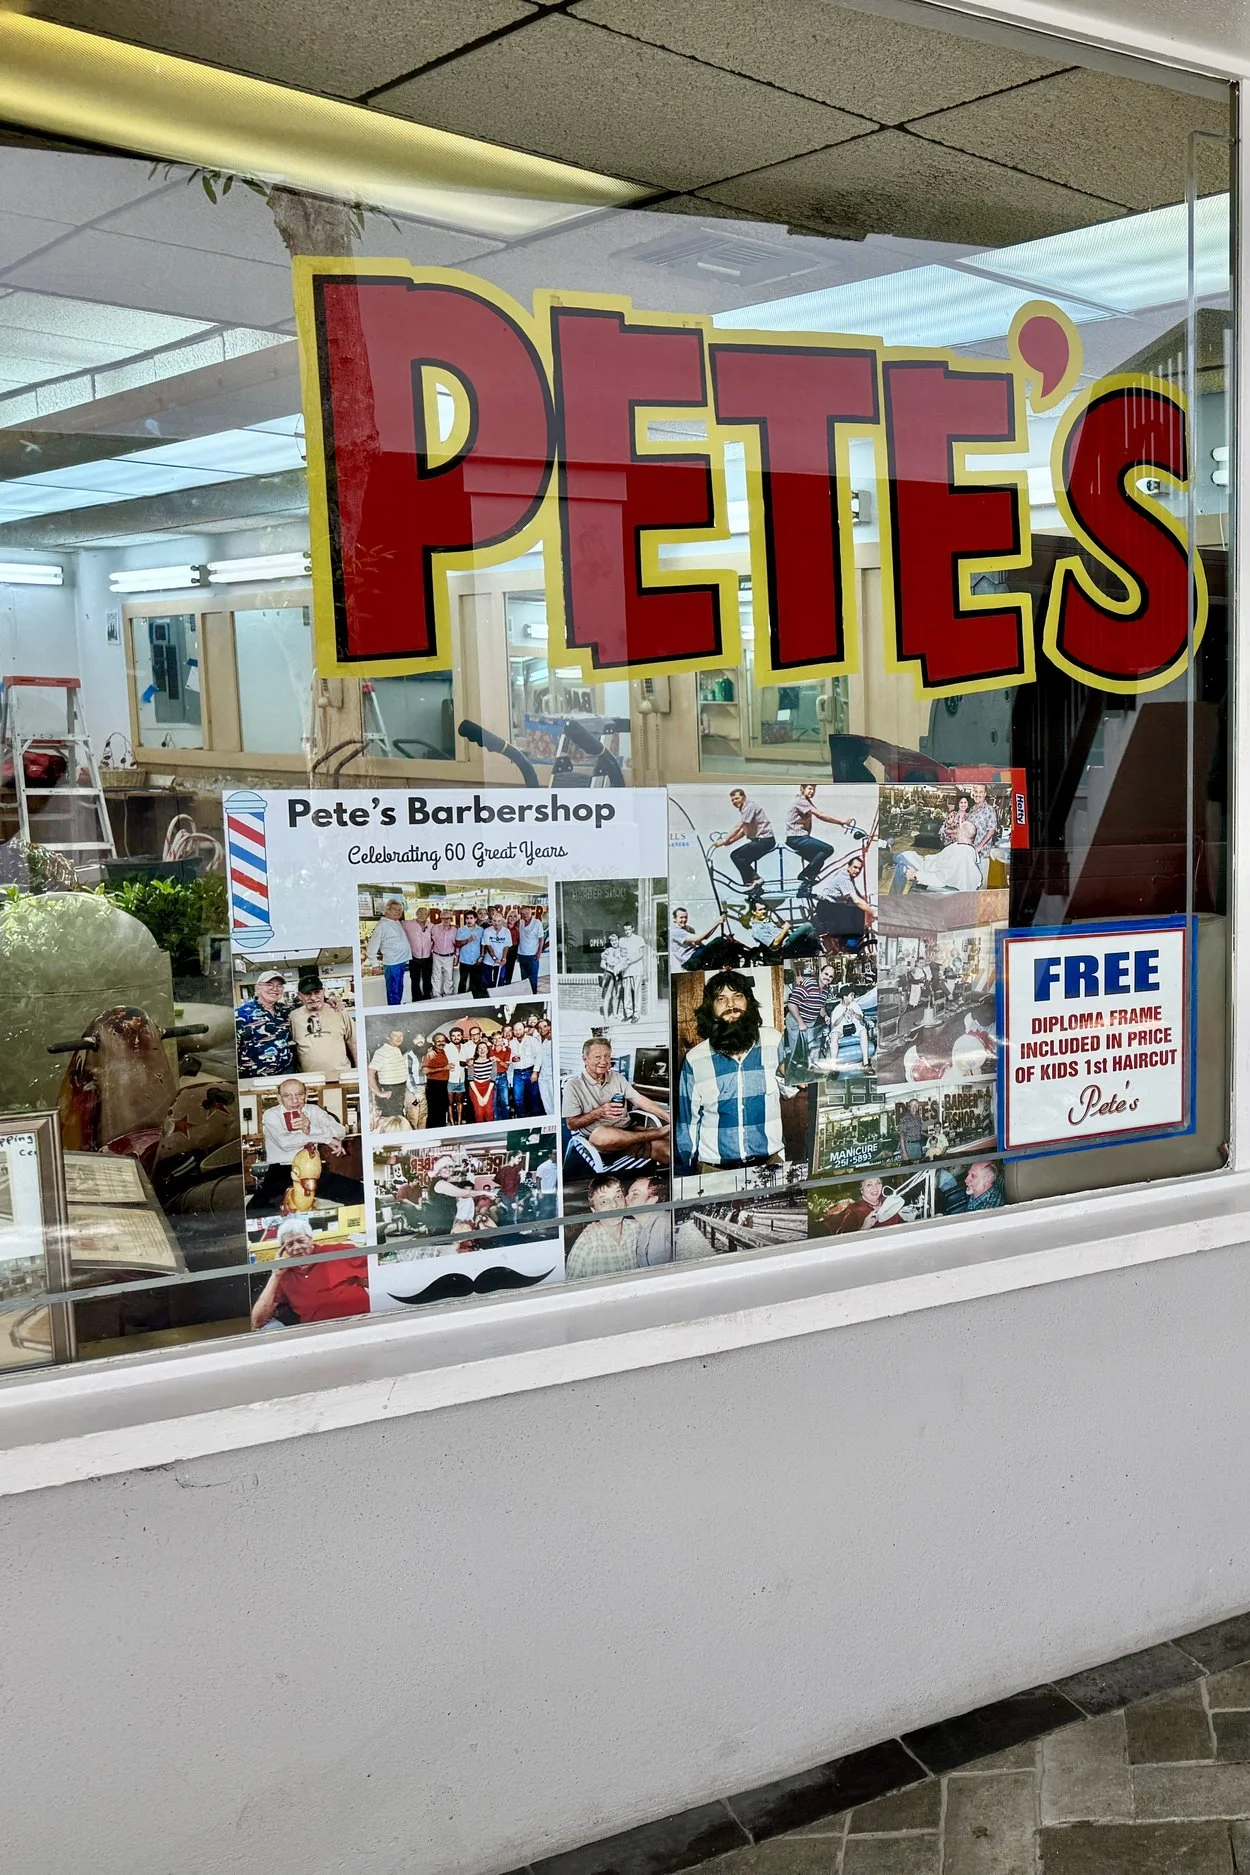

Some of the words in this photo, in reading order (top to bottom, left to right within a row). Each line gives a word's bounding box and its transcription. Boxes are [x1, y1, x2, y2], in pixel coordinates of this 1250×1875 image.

[292, 255, 1208, 699] PETE'S
[287, 796, 396, 828] Pete's
[408, 794, 616, 829] Barbershop
[348, 842, 441, 870] Celebrating
[444, 843, 466, 862] 60
[472, 842, 518, 868] Great
[519, 841, 568, 866] Years
[1034, 949, 1160, 1002] FREE
[1031, 1011, 1105, 1035] DIPLOMA
[1109, 1005, 1162, 1028] FRAME
[1020, 1035, 1101, 1060] INCLUDED
[1106, 1033, 1123, 1050] IN
[1127, 1027, 1172, 1047] PRICE
[1015, 1065, 1035, 1084] OF
[1040, 1060, 1079, 1081] KIDS
[1083, 1057, 1108, 1075] 1st
[1112, 1049, 1178, 1072] HAIRCUT
[1068, 1080, 1140, 1126] Pete's
[830, 1143, 878, 1162] MANICURE
